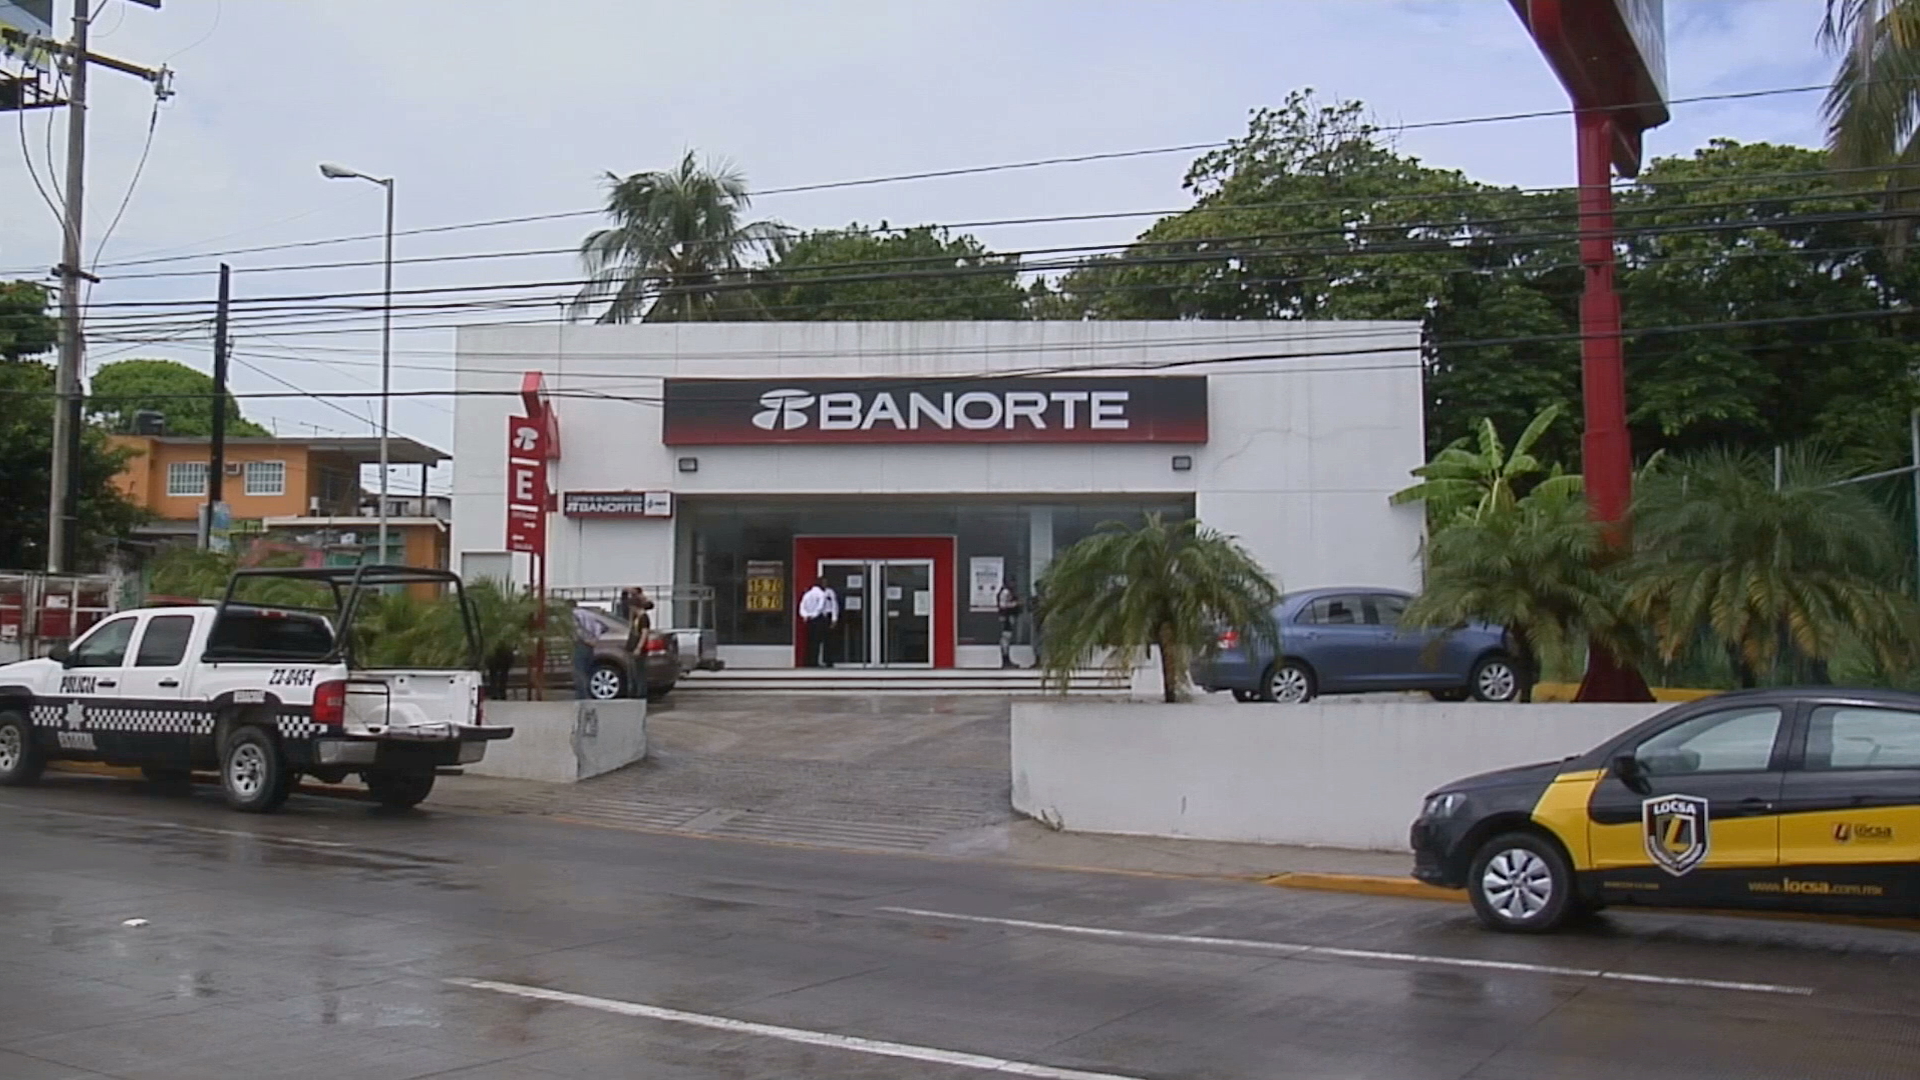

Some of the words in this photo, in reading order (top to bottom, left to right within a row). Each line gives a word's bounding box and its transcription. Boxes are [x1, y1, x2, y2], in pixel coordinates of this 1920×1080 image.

[819, 391, 1129, 431] BANORTE
[516, 469, 533, 500] E
[1653, 800, 1697, 815] LOCSA
